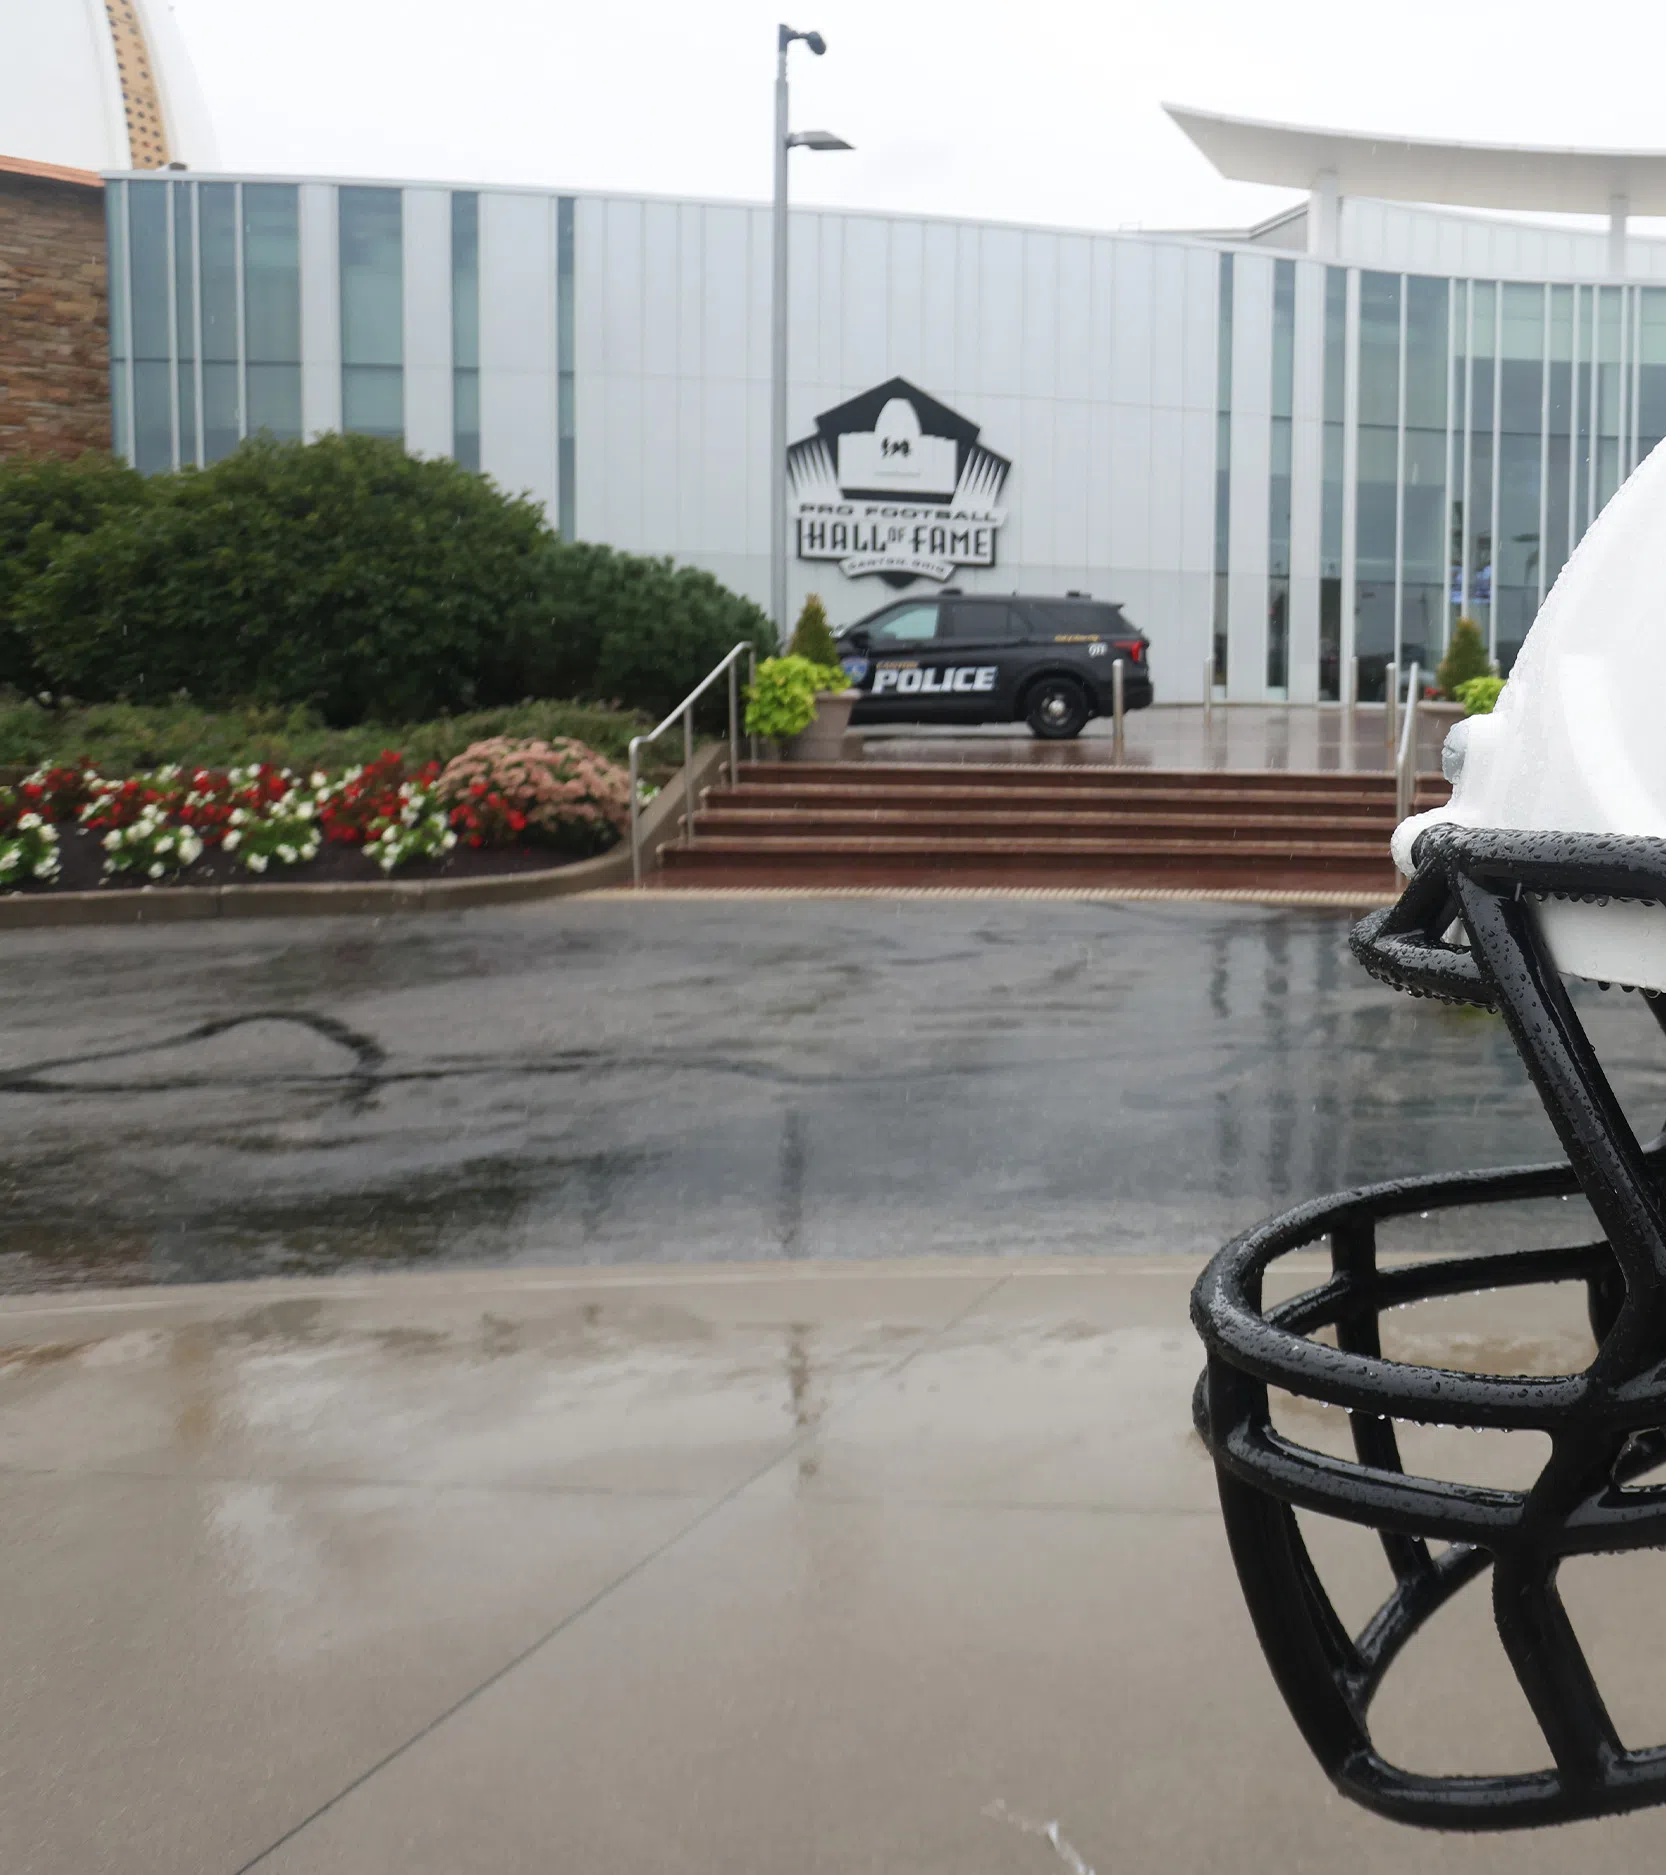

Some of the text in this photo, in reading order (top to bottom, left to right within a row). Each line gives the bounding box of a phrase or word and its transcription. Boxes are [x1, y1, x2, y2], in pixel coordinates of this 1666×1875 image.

[801, 504, 996, 521] PRO FOOTBALL
[802, 521, 988, 556] HALL OF FAME
[871, 667, 998, 694] POLICE
